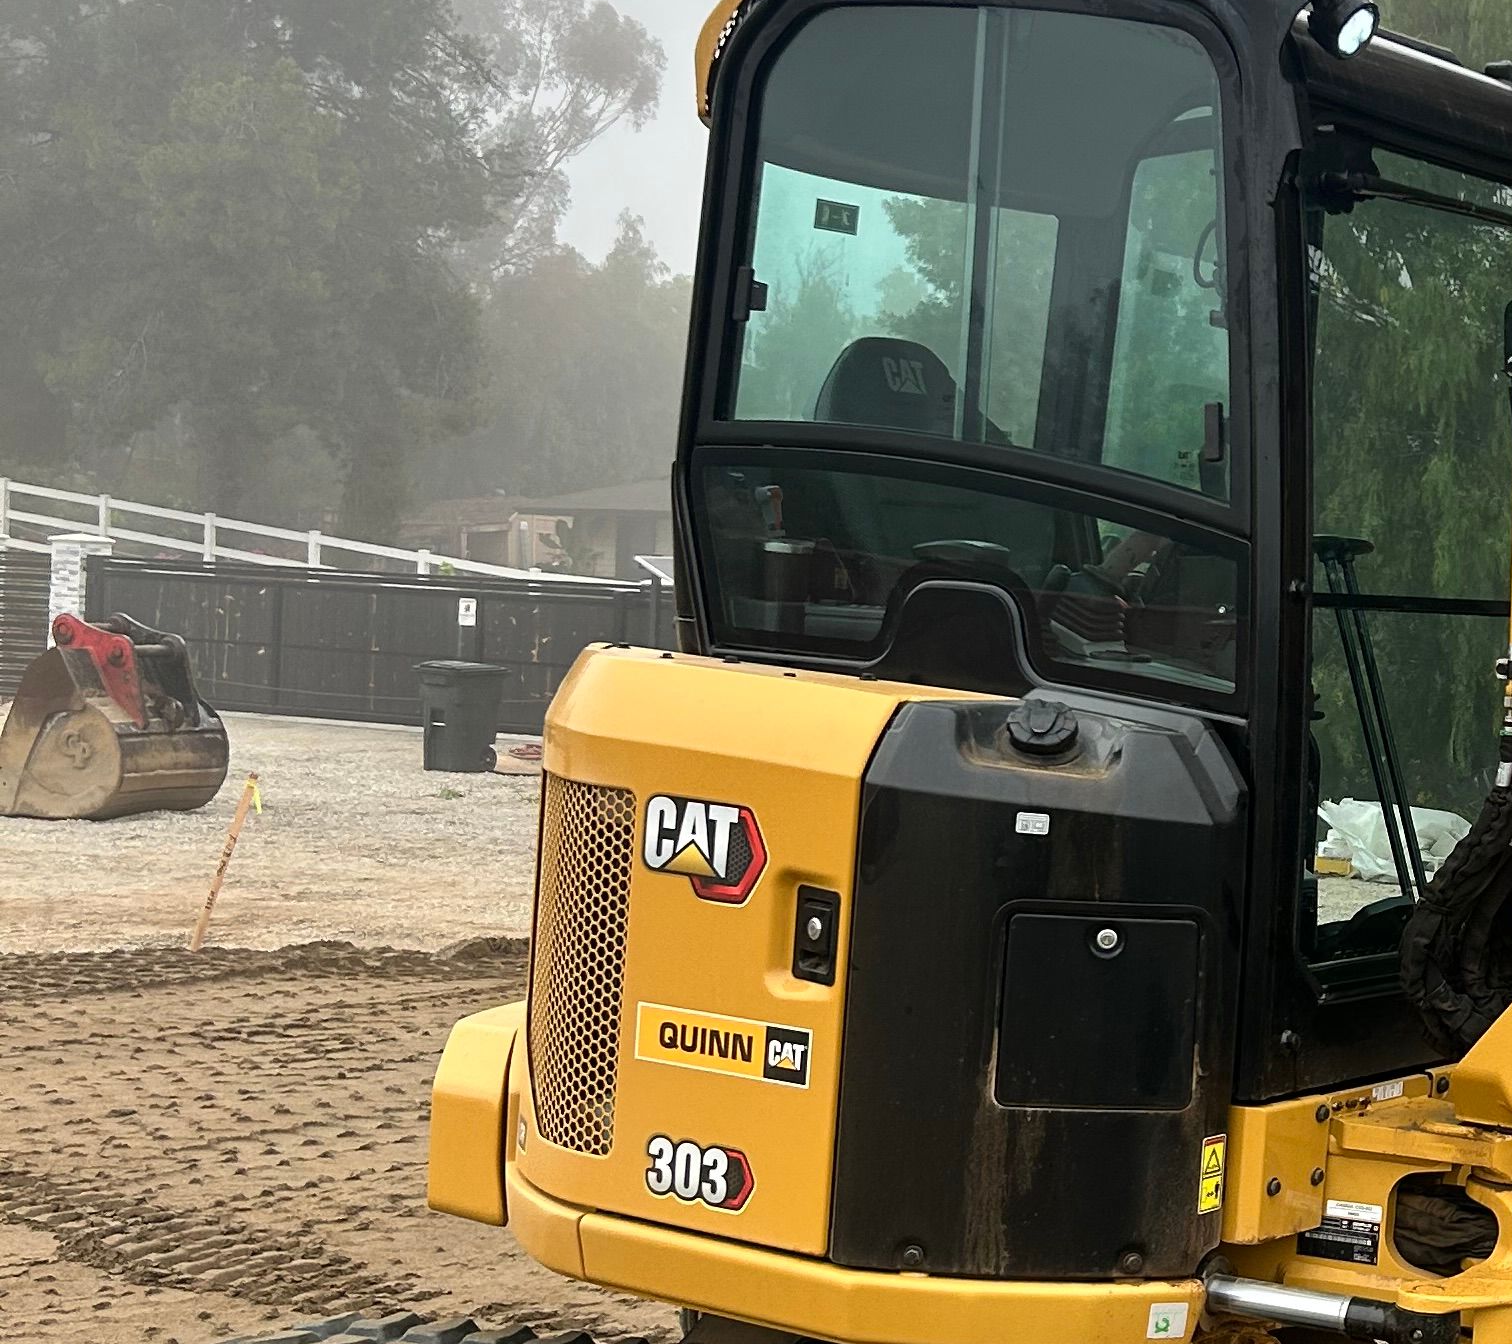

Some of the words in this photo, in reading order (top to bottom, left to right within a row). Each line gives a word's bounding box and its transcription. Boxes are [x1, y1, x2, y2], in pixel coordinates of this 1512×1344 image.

[882, 356, 928, 395] CAT
[643, 796, 740, 879] CAT
[659, 1022, 754, 1063] QUINN
[768, 1039, 805, 1072] CAT
[646, 1137, 729, 1204] 303
